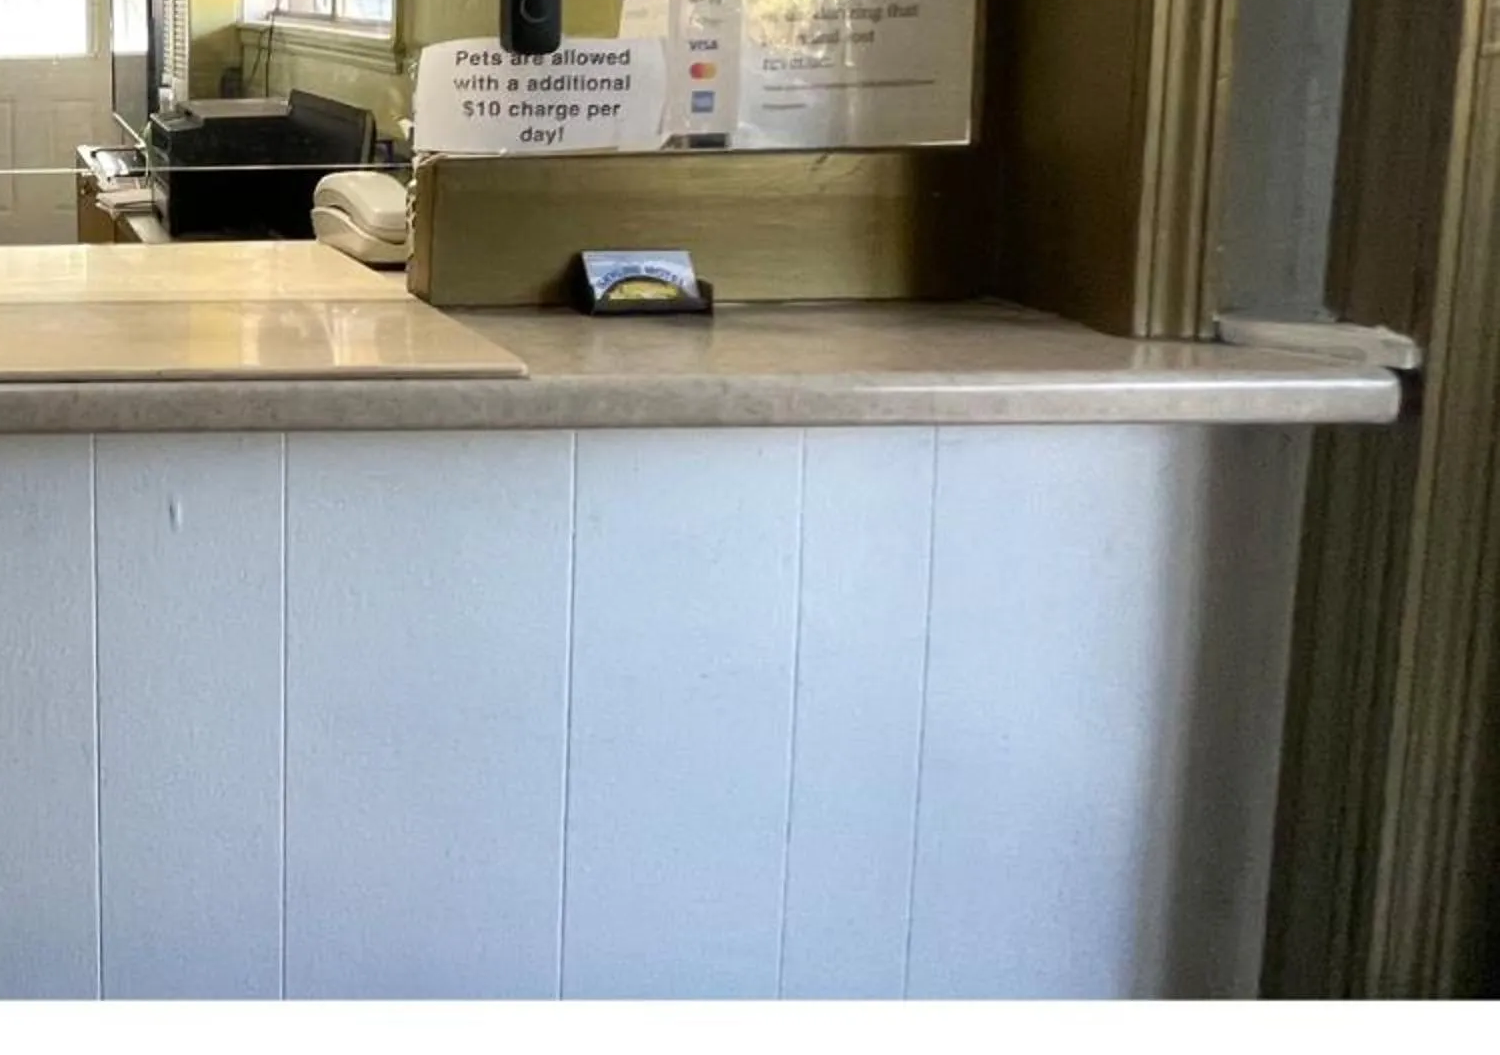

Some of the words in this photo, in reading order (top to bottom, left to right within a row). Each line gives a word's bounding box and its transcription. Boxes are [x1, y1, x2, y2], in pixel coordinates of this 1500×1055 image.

[887, 4, 919, 19] that
[688, 39, 718, 51] VISA
[455, 50, 503, 66] Pets
[509, 52, 545, 67] are
[551, 48, 631, 67] allowed
[453, 75, 499, 92] with
[507, 78, 519, 92] a
[527, 74, 631, 92] additional
[462, 99, 501, 118] $10
[508, 100, 581, 122] charge
[587, 103, 622, 123] per
[519, 127, 565, 145] day!
